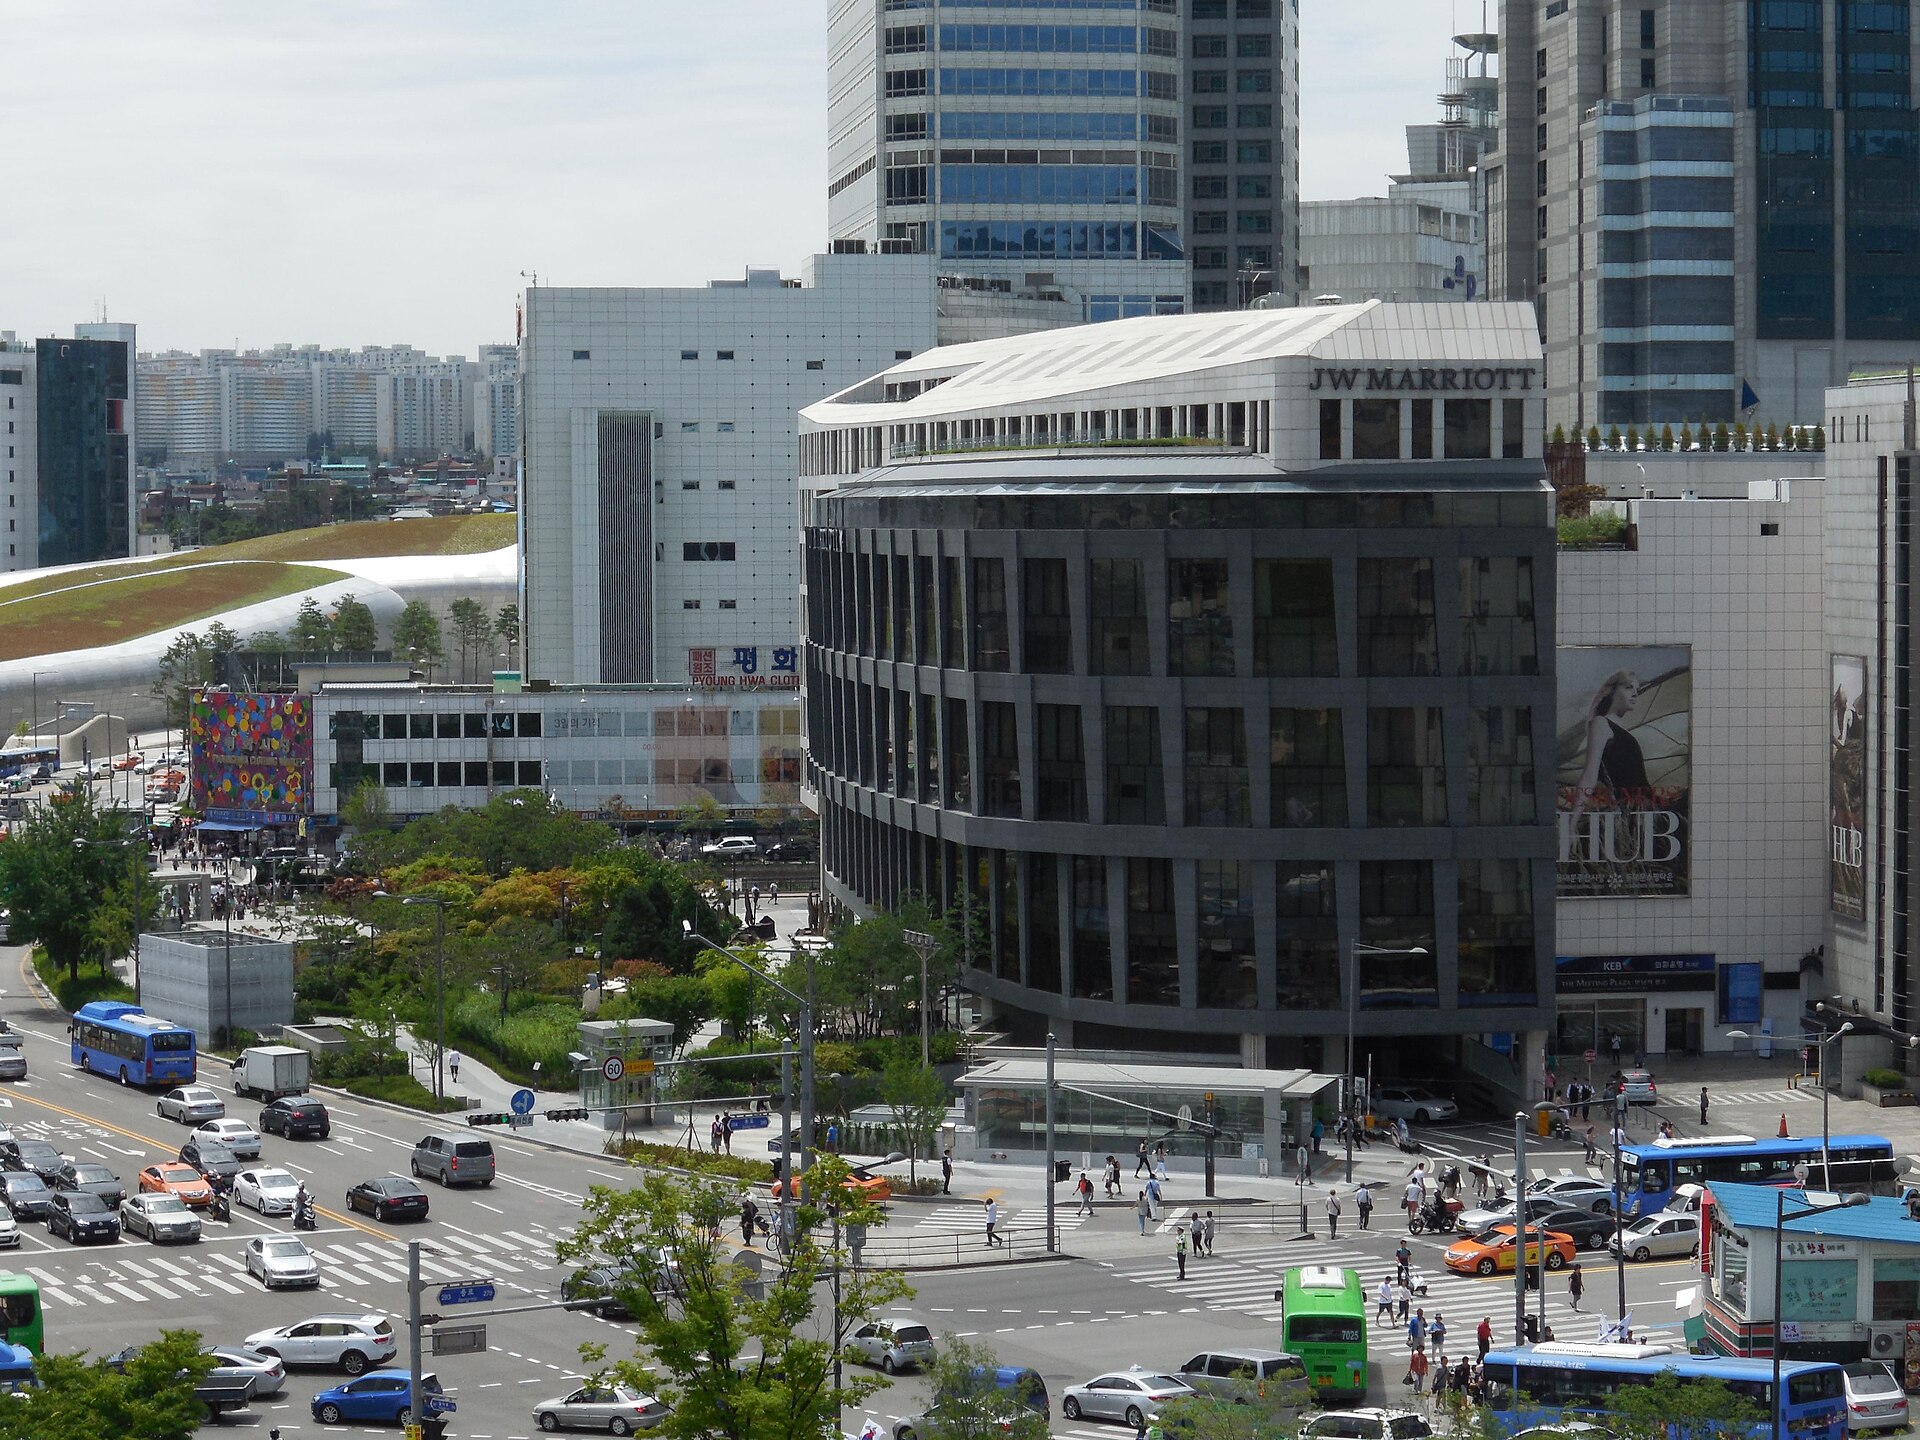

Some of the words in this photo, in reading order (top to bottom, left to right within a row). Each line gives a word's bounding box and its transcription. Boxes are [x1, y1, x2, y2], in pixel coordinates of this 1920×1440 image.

[1309, 368, 1360, 390] JW
[1365, 367, 1536, 391] MARRIOTT
[733, 646, 798, 674] 평화
[692, 675, 736, 687] PYOUNG
[740, 675, 766, 686] HWA
[1556, 810, 1681, 863] HUB
[1832, 824, 1862, 868] HUB
[1603, 961, 1622, 971] KEB
[607, 1063, 620, 1075] 60
[1806, 1242, 1826, 1255] 한복
[1341, 1330, 1359, 1341] 7025
